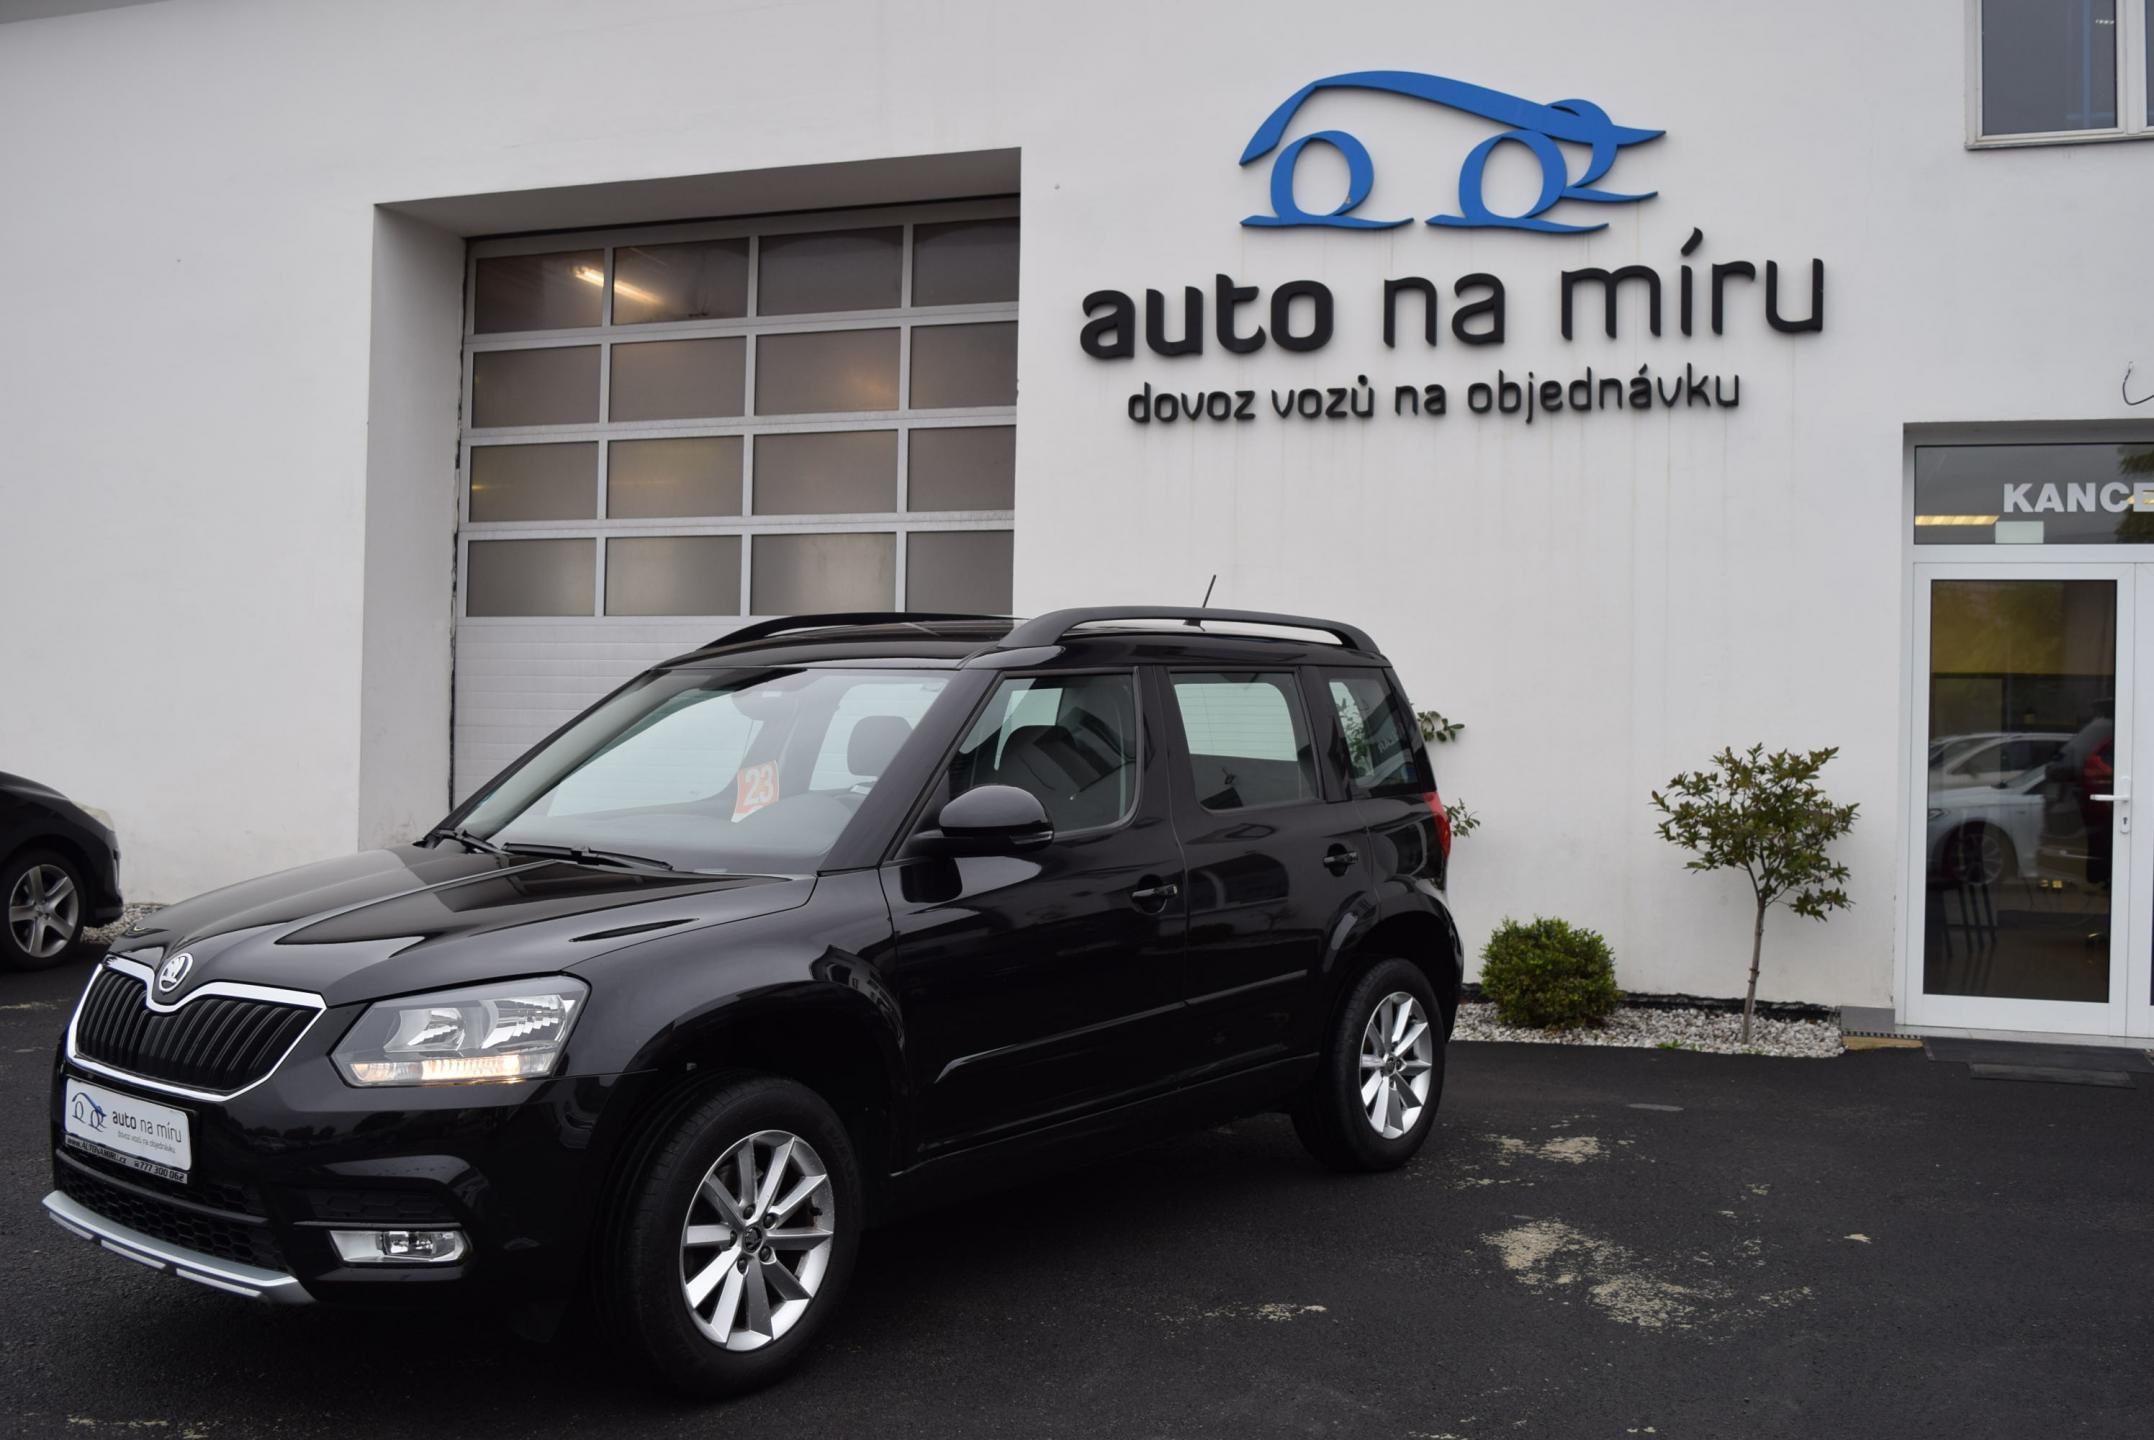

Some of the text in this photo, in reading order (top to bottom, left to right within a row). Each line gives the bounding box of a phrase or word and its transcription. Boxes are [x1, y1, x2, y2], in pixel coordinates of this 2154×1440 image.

[1079, 227, 1824, 363] auto na míru
[1127, 362, 1740, 426] dovoz vozů na objednávku
[2003, 482, 2154, 513] KANCE
[743, 765, 774, 805] 23
[112, 1110, 182, 1143] auto na míru
